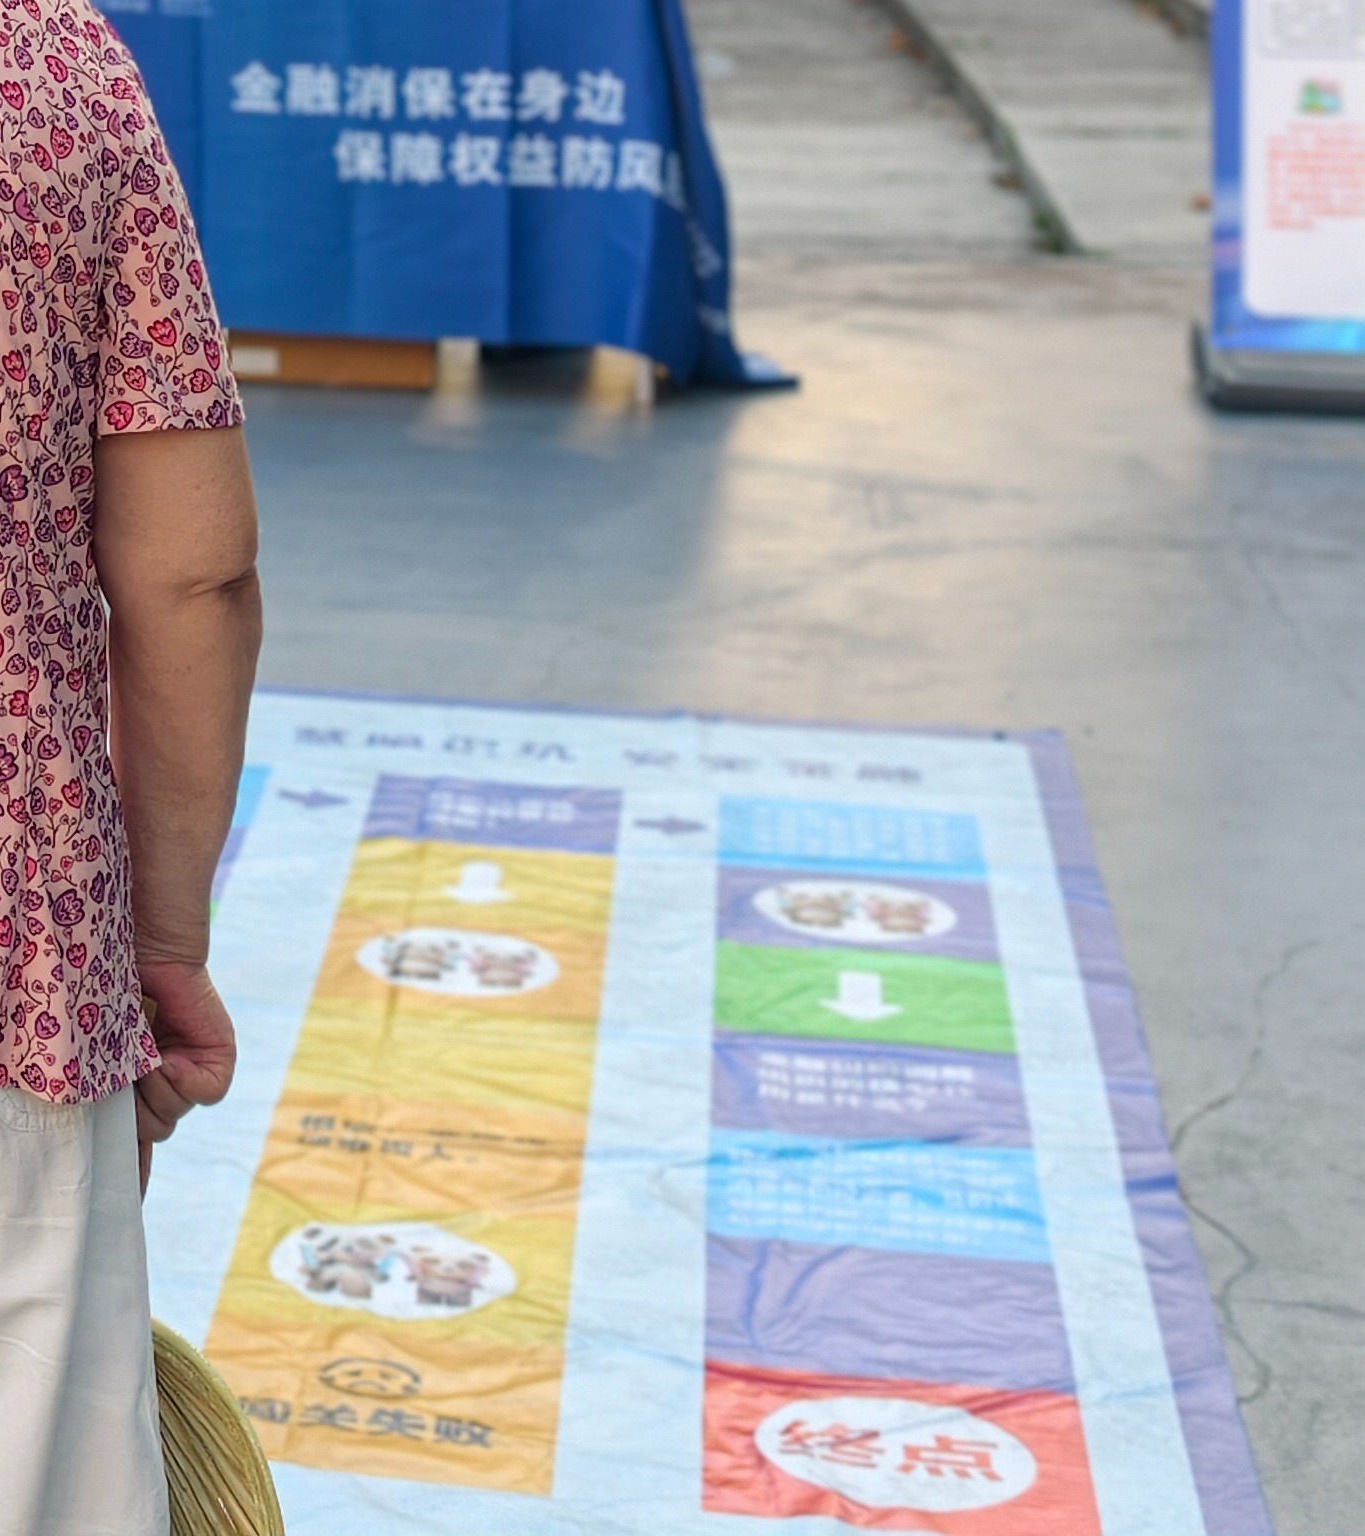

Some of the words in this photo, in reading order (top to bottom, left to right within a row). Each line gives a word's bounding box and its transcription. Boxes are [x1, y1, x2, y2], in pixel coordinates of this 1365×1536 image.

[230, 63, 626, 125] 金融消保在身边
[333, 129, 685, 206] 保障权益防风
[778, 1419, 1003, 1482] 终点
